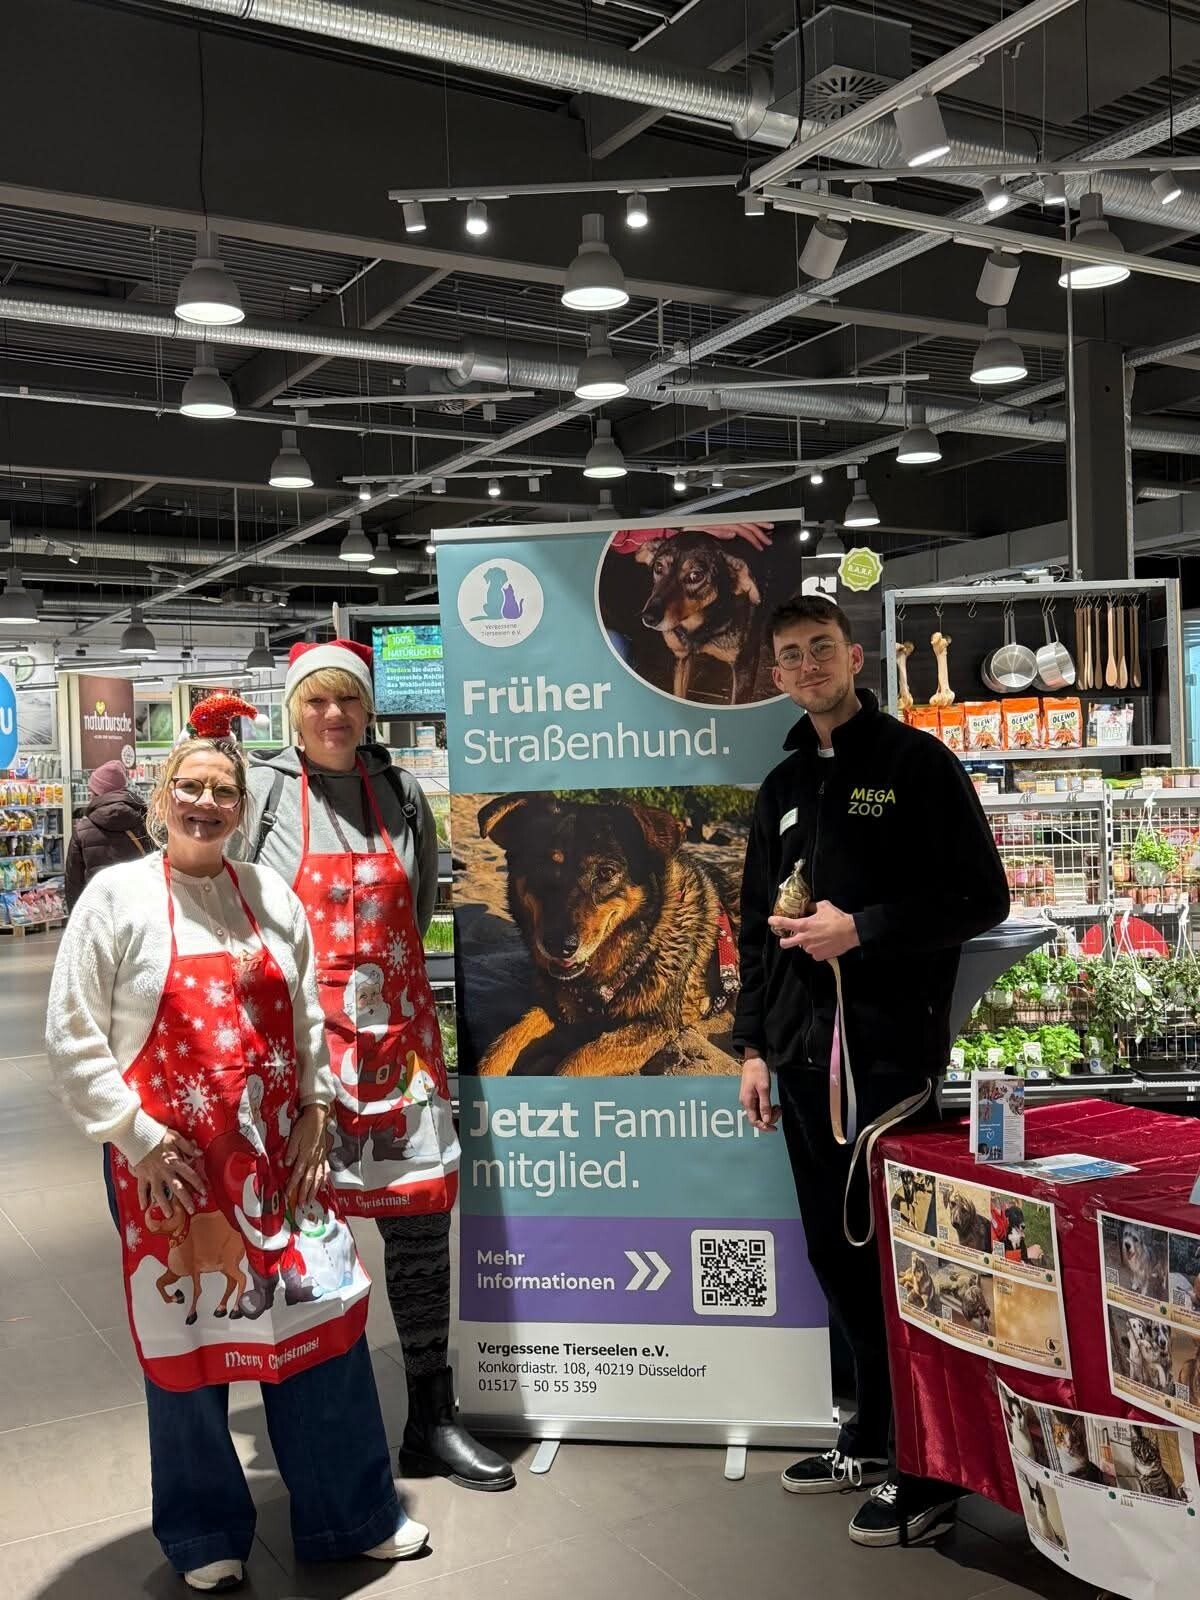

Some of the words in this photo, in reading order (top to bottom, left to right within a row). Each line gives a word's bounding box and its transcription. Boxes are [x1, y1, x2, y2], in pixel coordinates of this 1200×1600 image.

[462, 675, 611, 716] Früher
[83, 711, 132, 732] naturbursche
[1011, 713, 1034, 725] OLEWO
[1052, 711, 1076, 723] OLEWO
[463, 718, 730, 764] Straßenhund.
[850, 787, 896, 804] MEGA
[847, 801, 884, 817] ZOO
[469, 1100, 580, 1138] Jetzt
[471, 1150, 640, 1198] mitglied.
[477, 1249, 525, 1266] Mehr
[477, 1271, 615, 1290] Informationen
[224, 1350, 264, 1369] Merry
[268, 1336, 320, 1370] Christmas!
[477, 1342, 560, 1357] Vergessene
[563, 1343, 638, 1357] Tierseelen
[641, 1345, 670, 1357] e.V.
[478, 1361, 558, 1374] Konkordiastr.
[563, 1362, 590, 1377] 108,
[594, 1363, 634, 1376] 40219
[638, 1364, 707, 1377] Düsseldorf
[478, 1379, 517, 1392] 01517
[533, 1380, 549, 1392] 50
[553, 1380, 569, 1393] 55
[573, 1381, 597, 1393] 359
